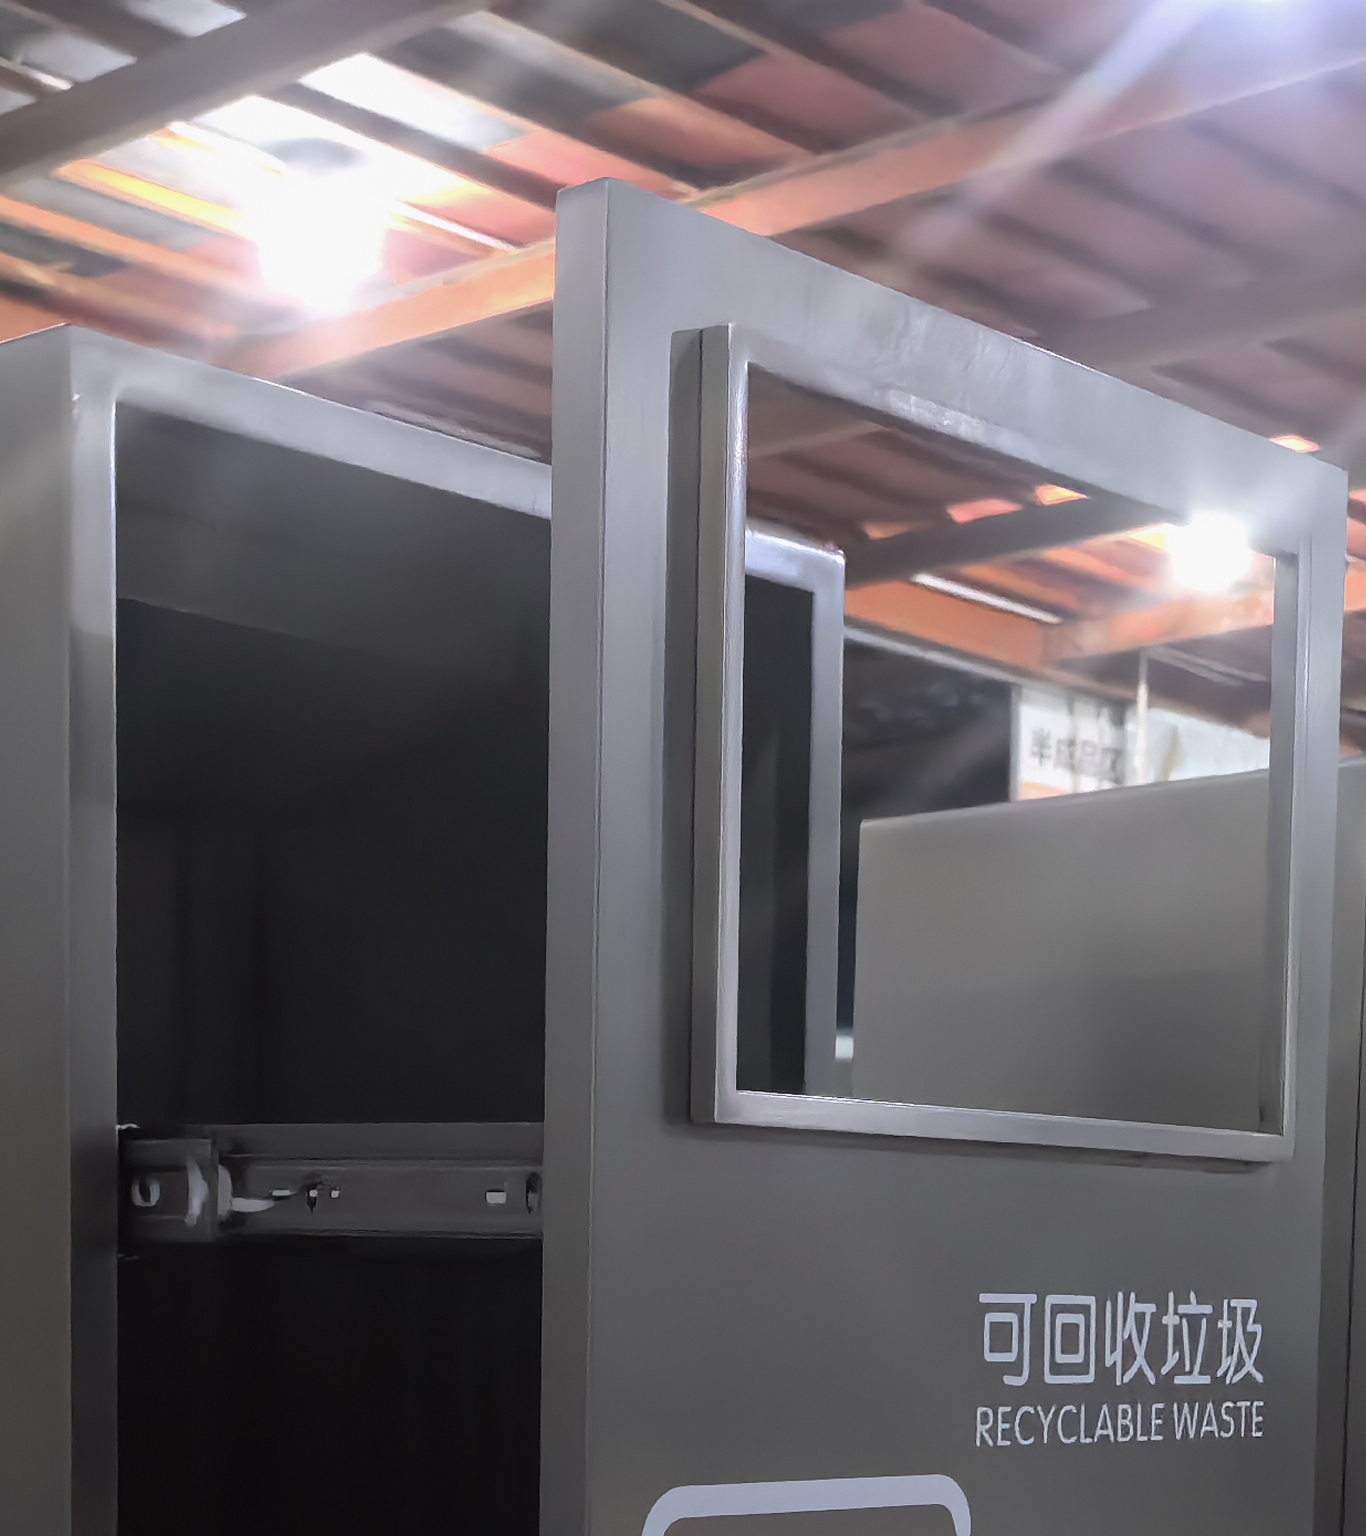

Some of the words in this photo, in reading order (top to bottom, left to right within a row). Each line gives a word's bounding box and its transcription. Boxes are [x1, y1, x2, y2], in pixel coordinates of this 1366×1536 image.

[978, 1289, 1265, 1387] 可回收垃圾
[975, 1402, 1166, 1448] RECYCLABLE
[1172, 1399, 1266, 1441] WASTE
